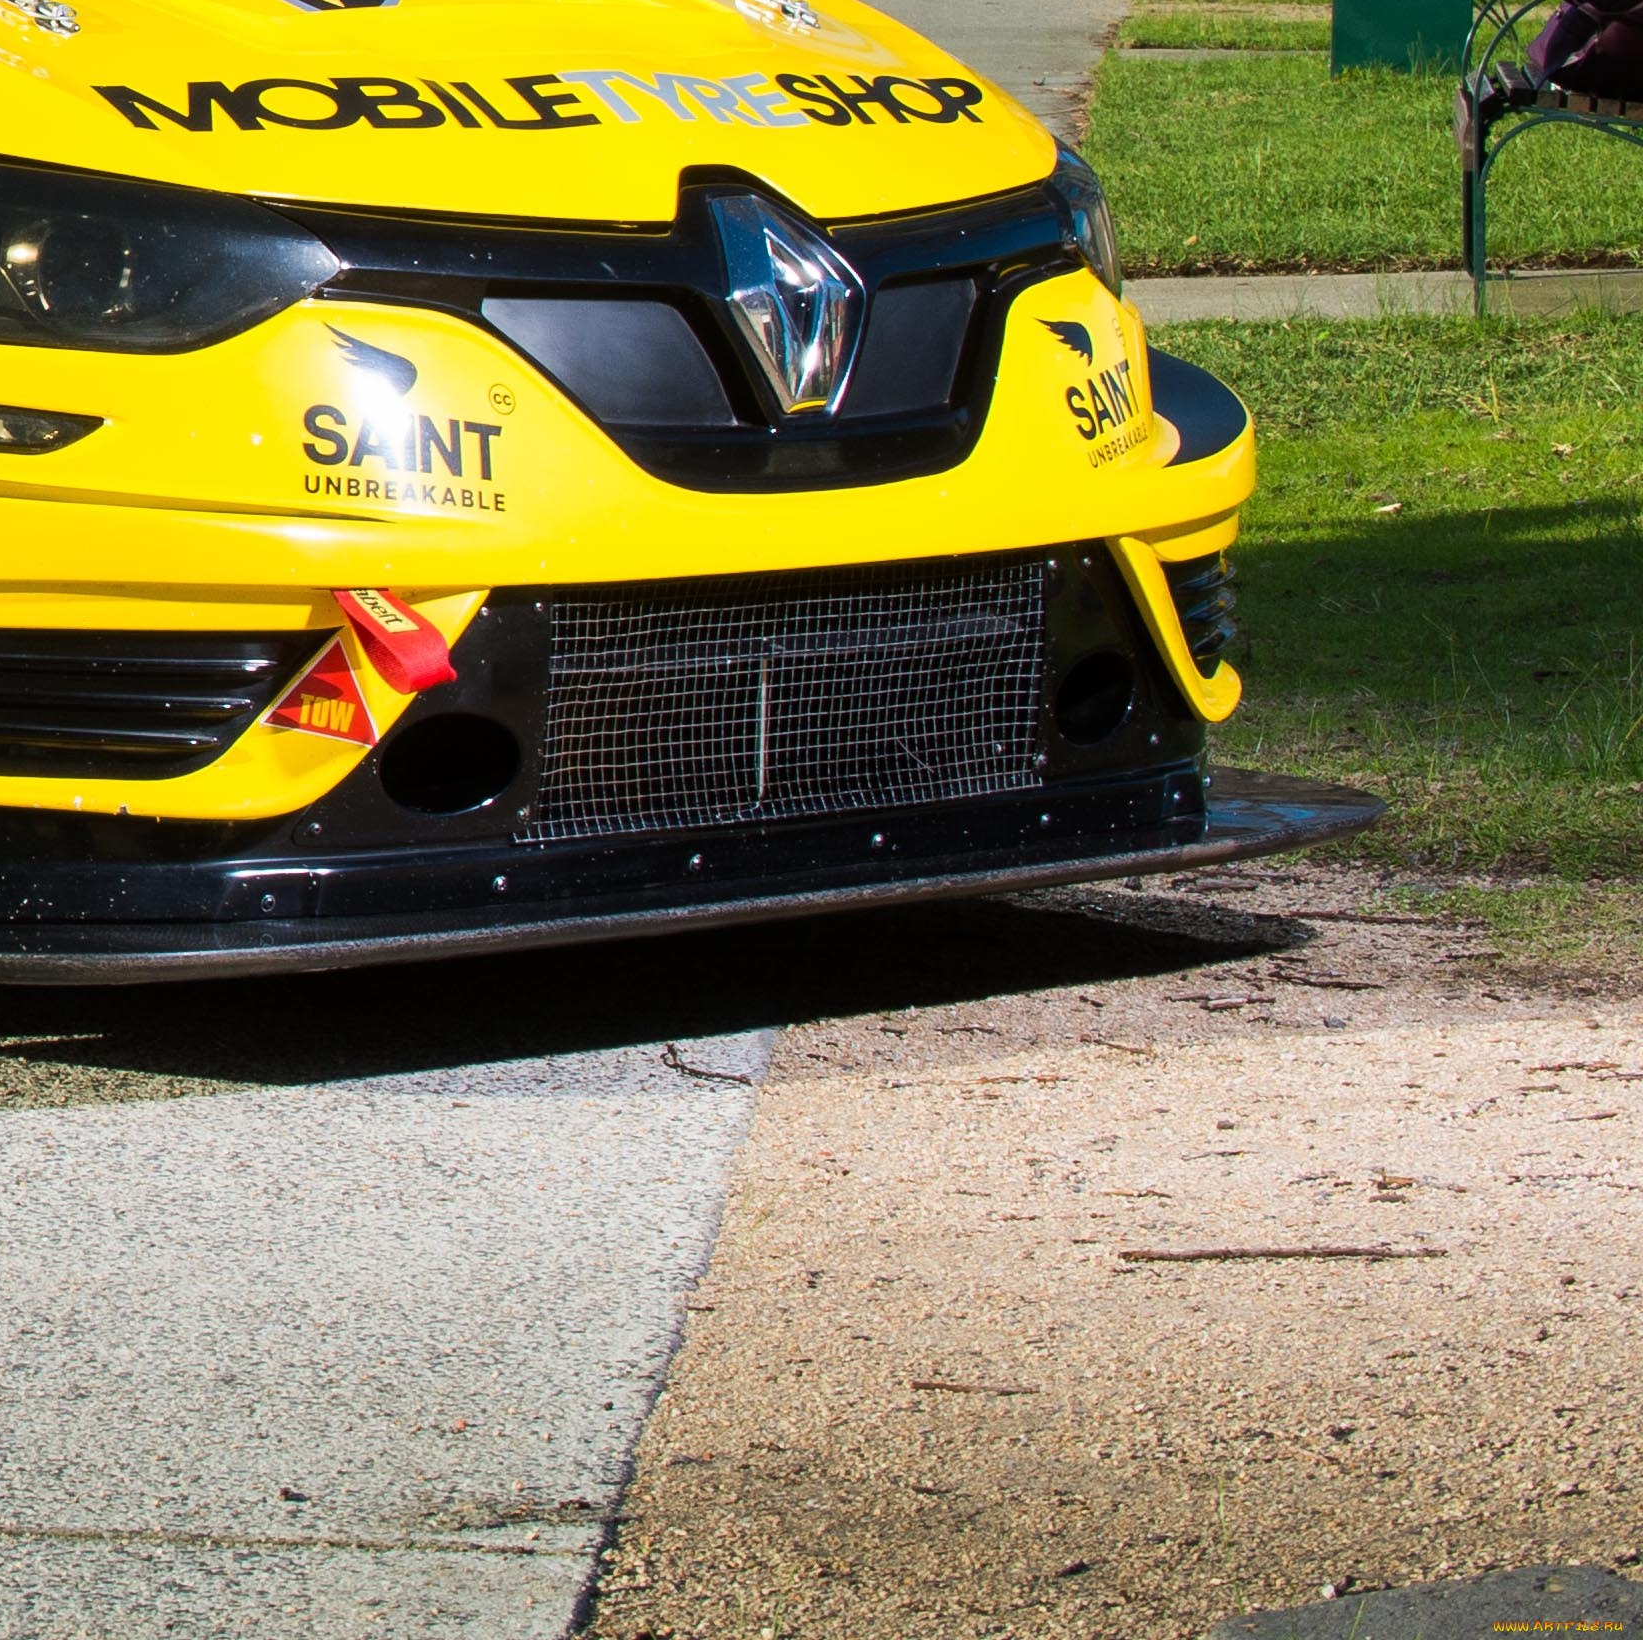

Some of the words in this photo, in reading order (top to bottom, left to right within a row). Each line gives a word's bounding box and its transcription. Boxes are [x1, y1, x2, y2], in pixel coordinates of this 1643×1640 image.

[1065, 358, 1140, 441] SAINT
[302, 404, 503, 481] SAINT
[304, 474, 506, 512] UNBREAKABLE
[299, 693, 356, 734] TOW
